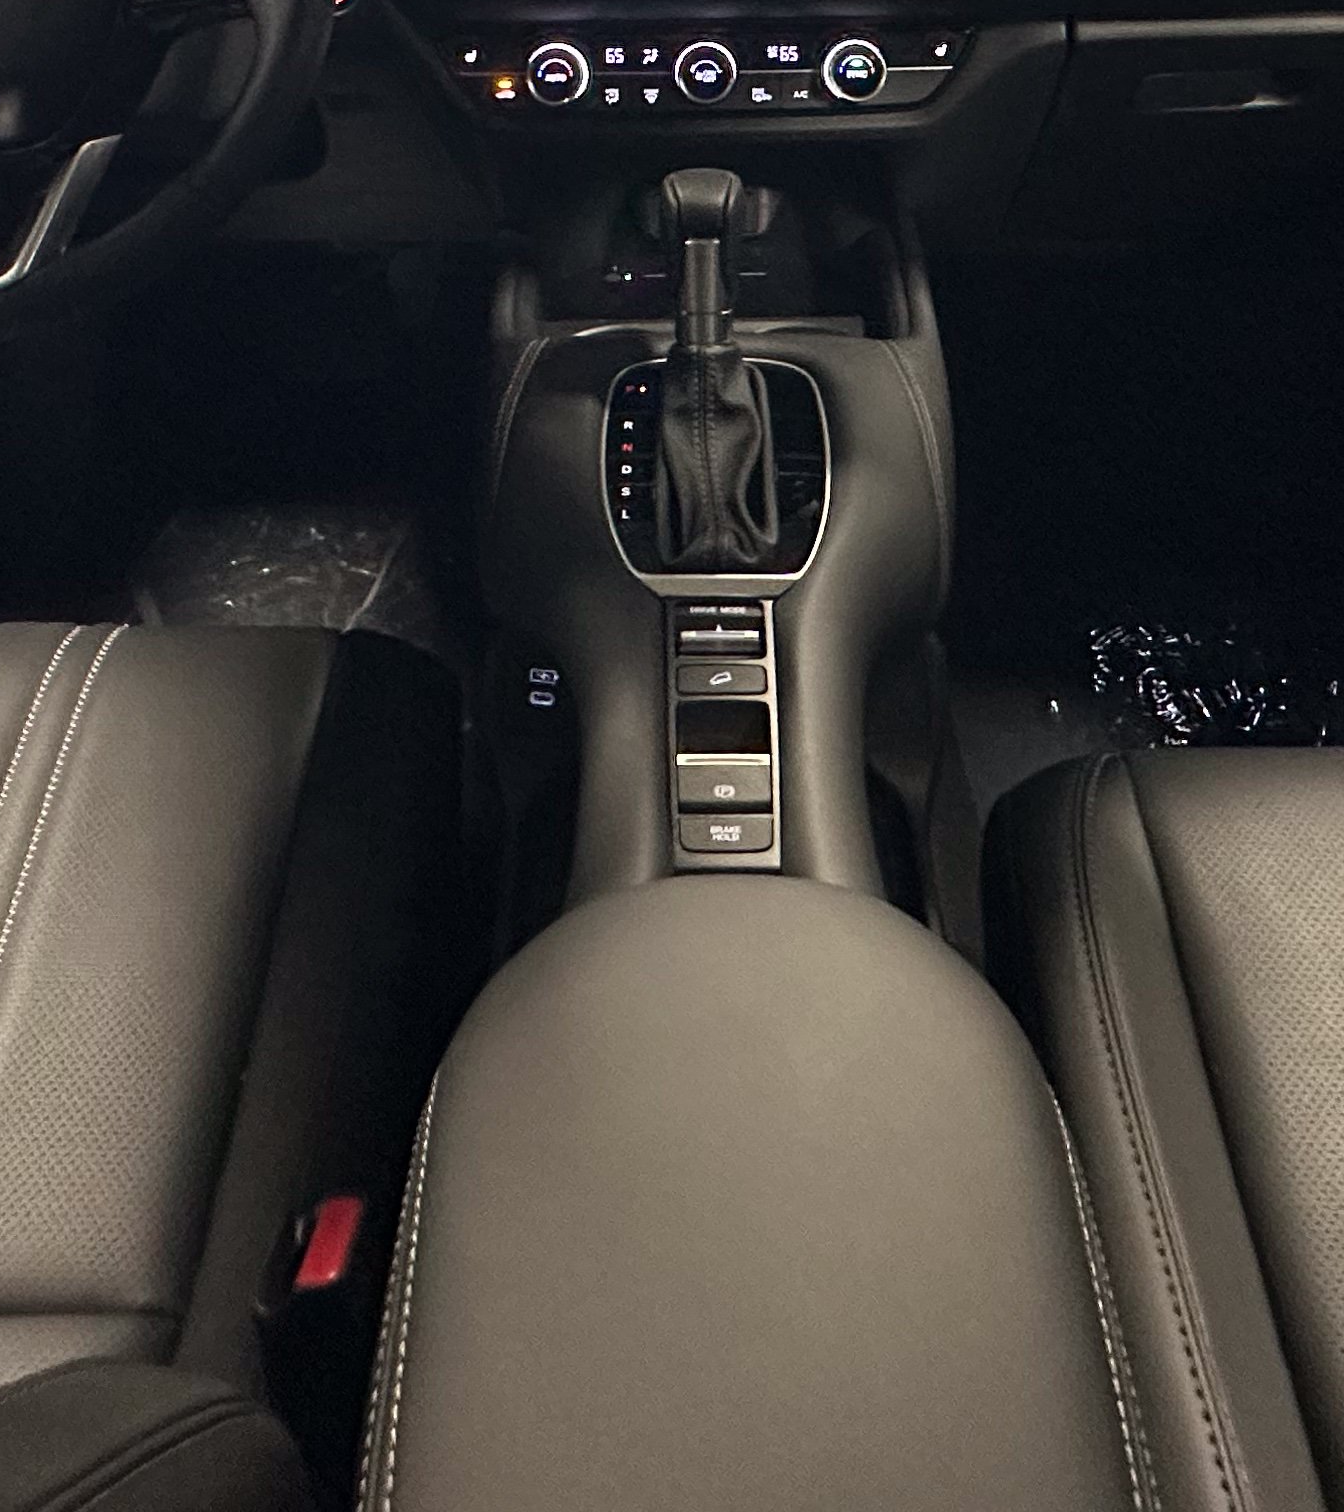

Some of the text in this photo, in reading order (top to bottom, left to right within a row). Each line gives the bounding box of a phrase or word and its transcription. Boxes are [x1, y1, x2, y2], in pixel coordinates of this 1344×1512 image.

[605, 48, 625, 64] 65
[779, 45, 799, 62] 65
[623, 420, 634, 431] R
[621, 464, 633, 475] D
[621, 486, 632, 497] S
[621, 509, 631, 520] L
